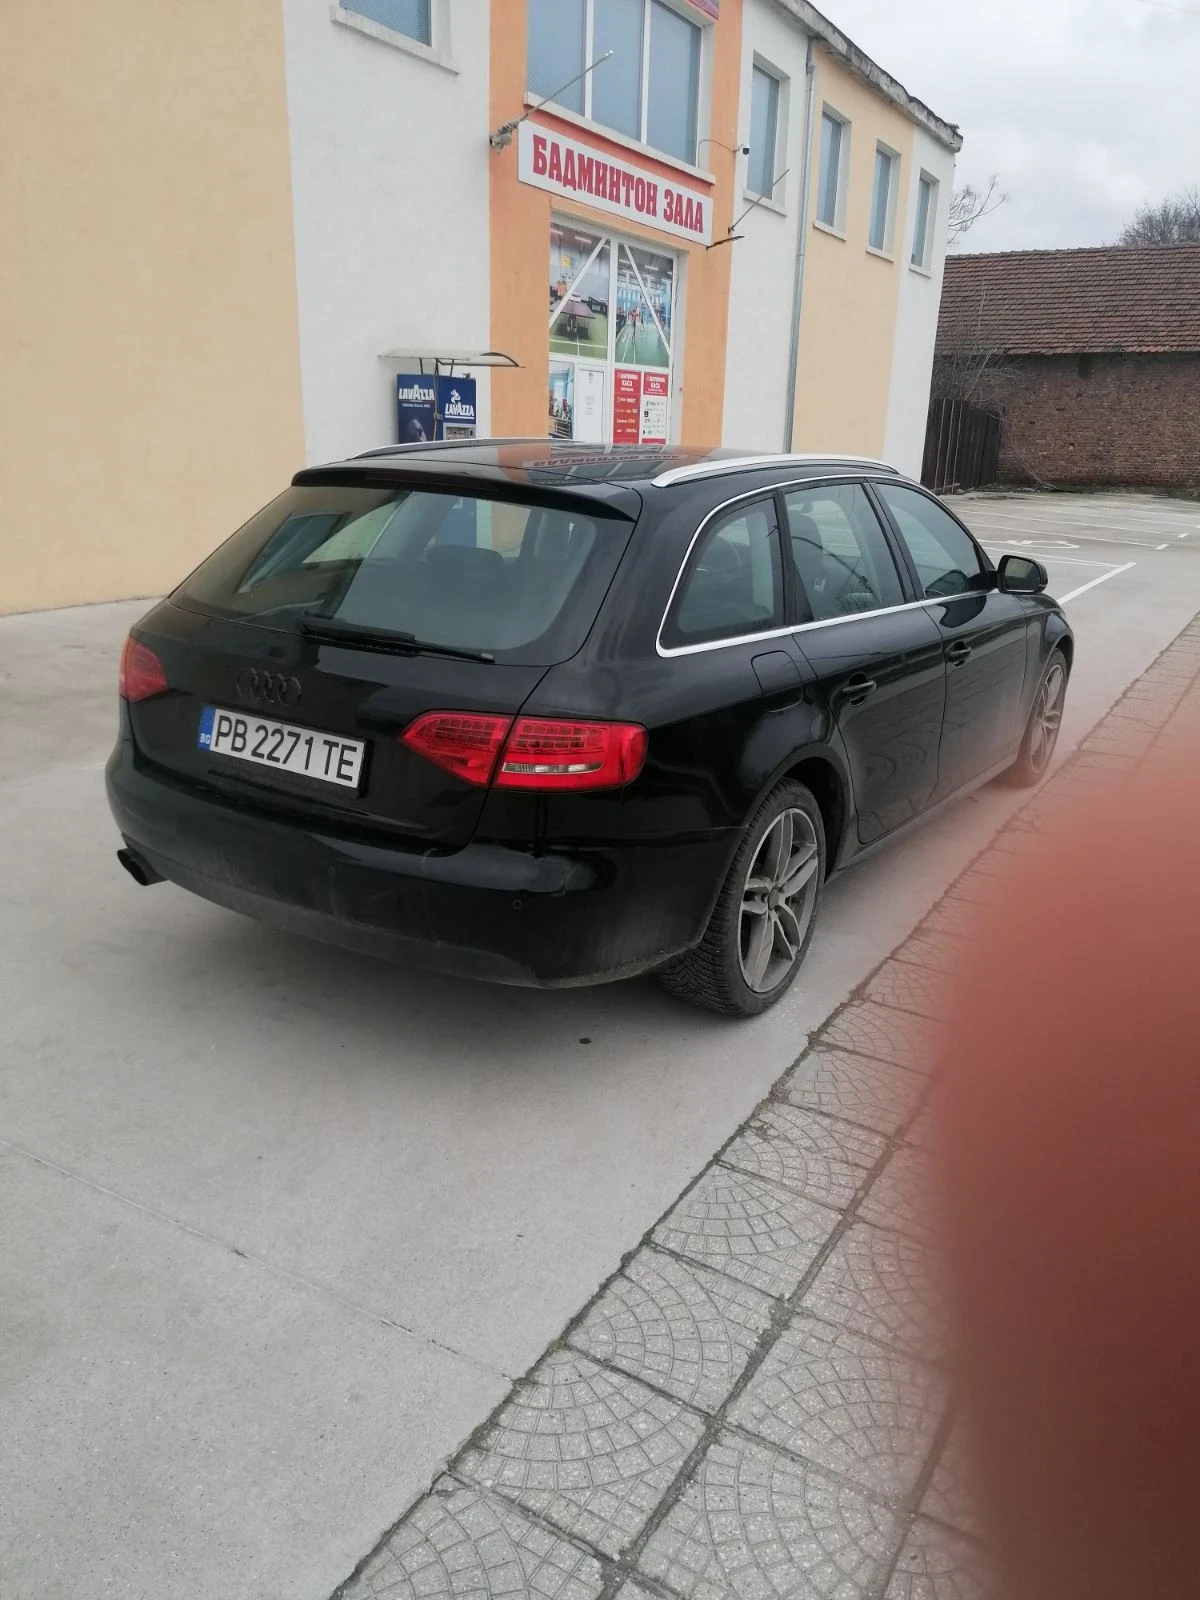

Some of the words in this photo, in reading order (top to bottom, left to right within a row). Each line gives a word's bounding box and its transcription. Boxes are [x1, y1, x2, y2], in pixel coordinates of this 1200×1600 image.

[533, 134, 658, 217] БАДМИНТОН
[663, 189, 703, 233] ЗАЛА
[399, 384, 435, 400] LAVAZZA
[445, 402, 475, 417] LAVAZZA
[200, 733, 212, 745] BG
[214, 714, 248, 753] PB
[251, 724, 314, 770] 2271
[322, 739, 358, 782] TE
